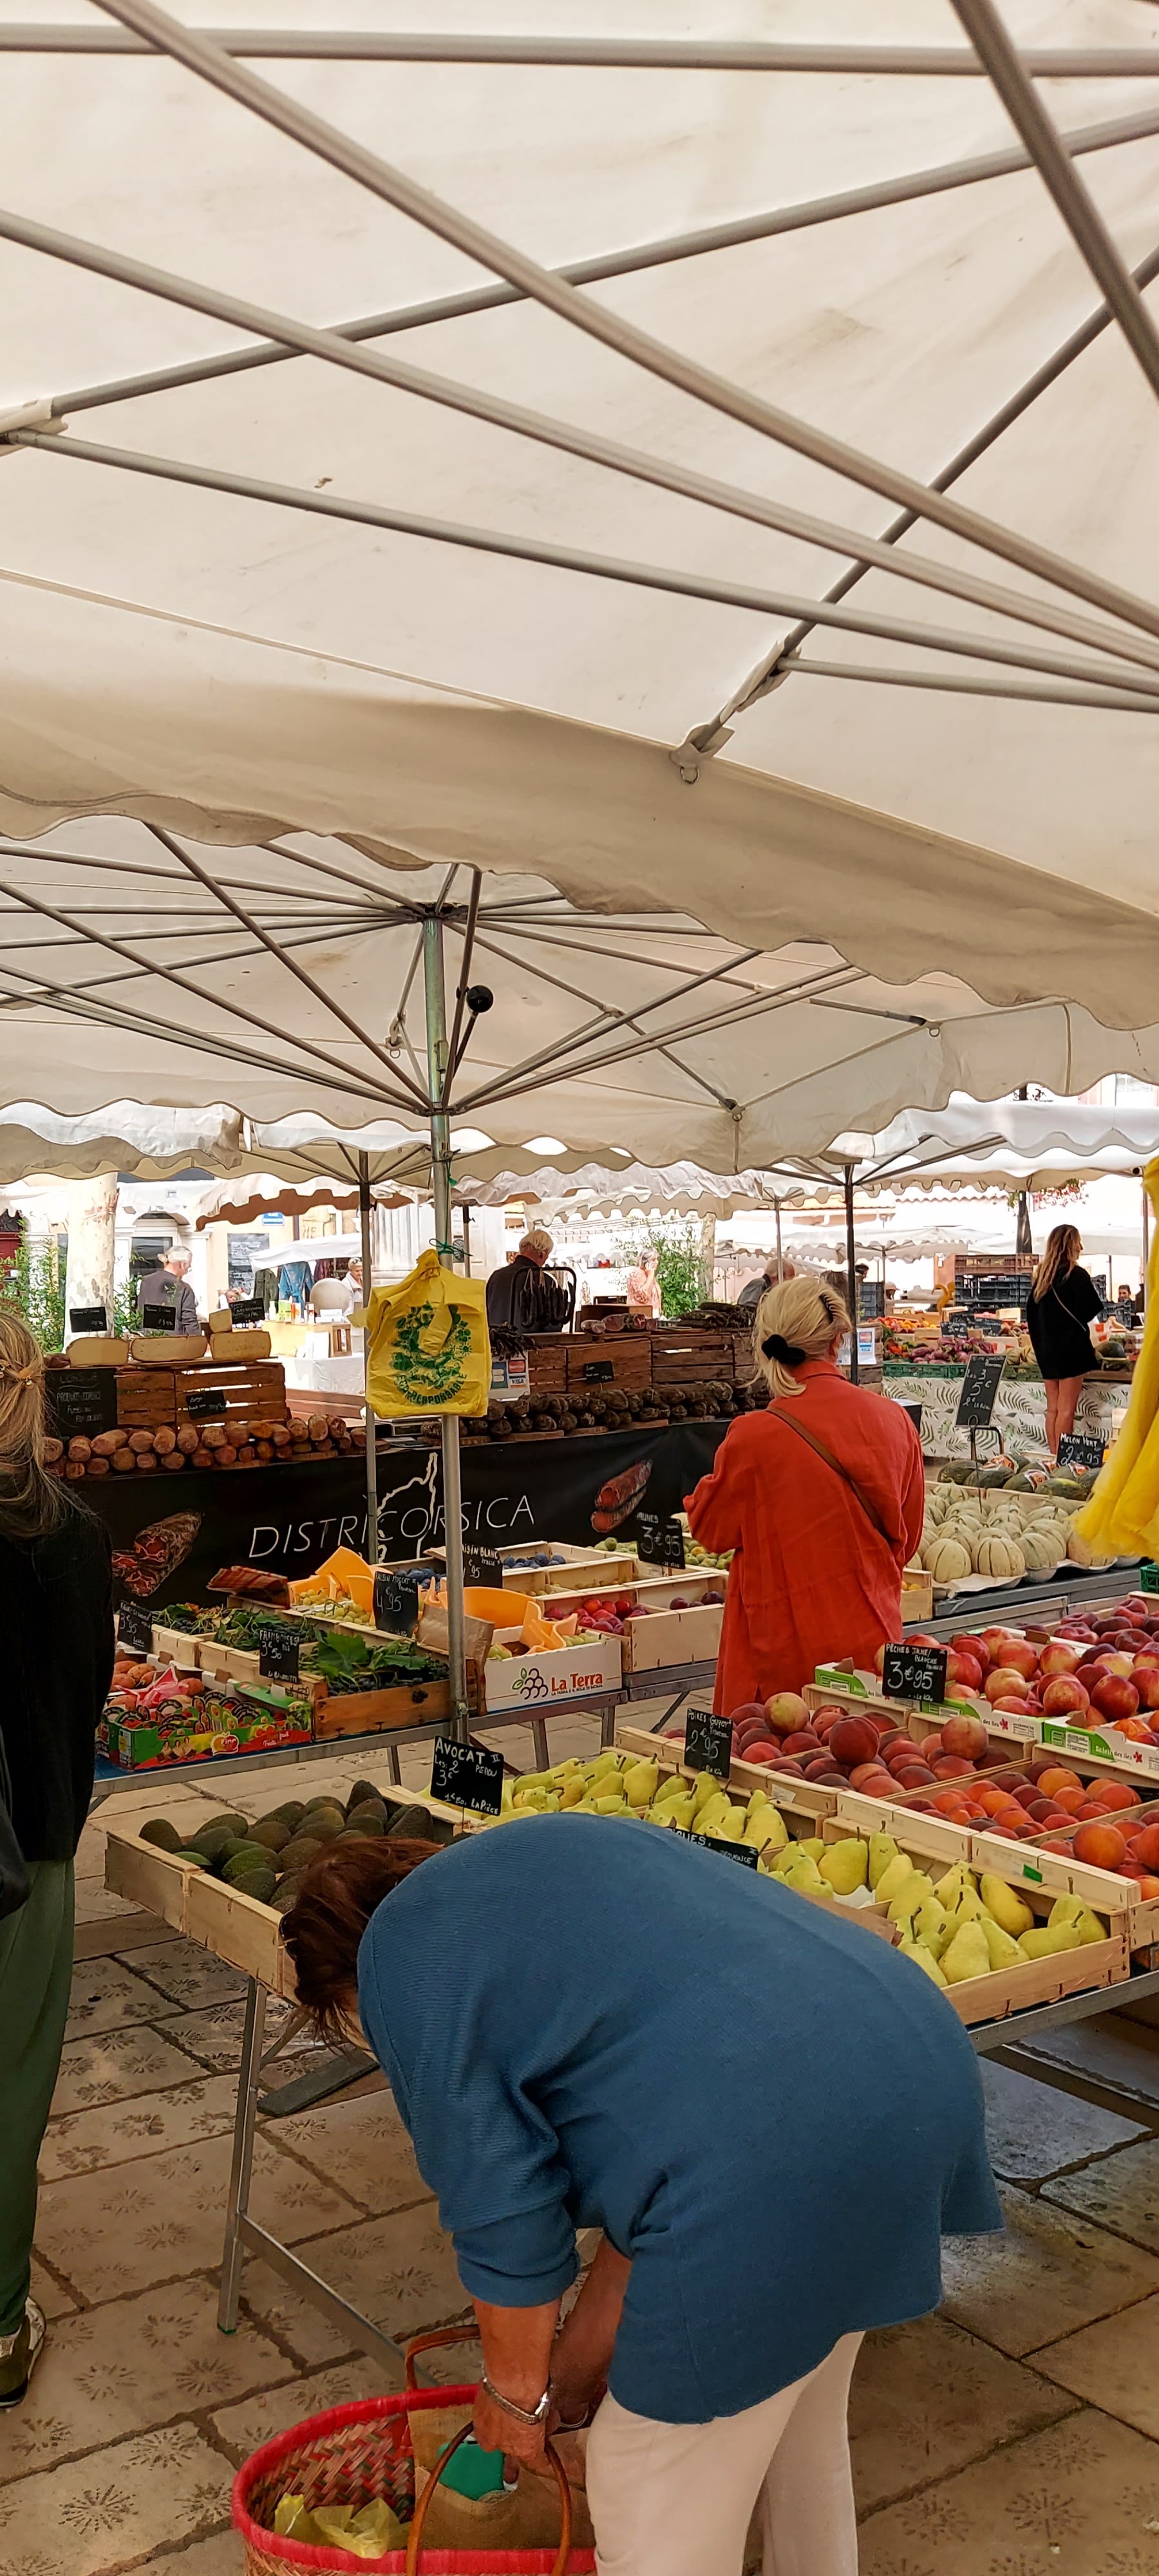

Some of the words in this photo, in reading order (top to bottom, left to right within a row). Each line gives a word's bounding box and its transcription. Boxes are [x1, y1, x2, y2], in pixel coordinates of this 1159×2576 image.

[551, 1676, 567, 1692] La
[570, 1672, 603, 1688] Terra
[435, 1737, 485, 1765] AVOCAT
[449, 1760, 459, 1773] 2
